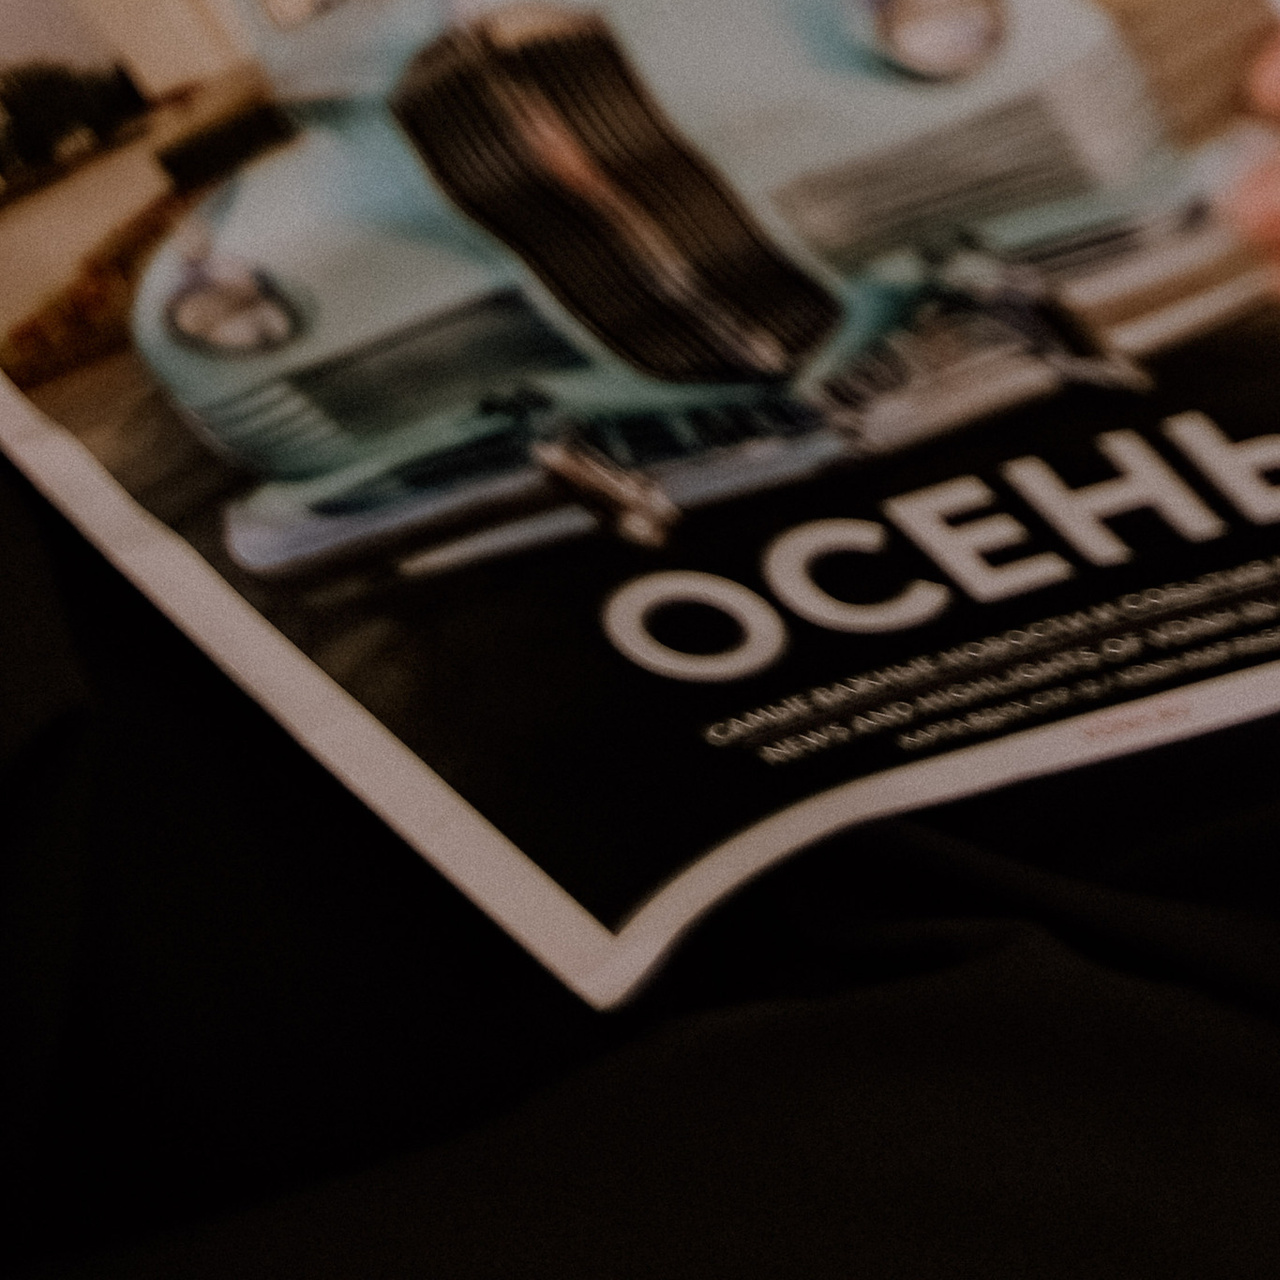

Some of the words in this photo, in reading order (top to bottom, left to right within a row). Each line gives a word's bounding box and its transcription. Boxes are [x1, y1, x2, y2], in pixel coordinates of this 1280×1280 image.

[757, 722, 853, 764] NEWS
[850, 701, 921, 736] AND
[1099, 634, 1152, 662] OF
